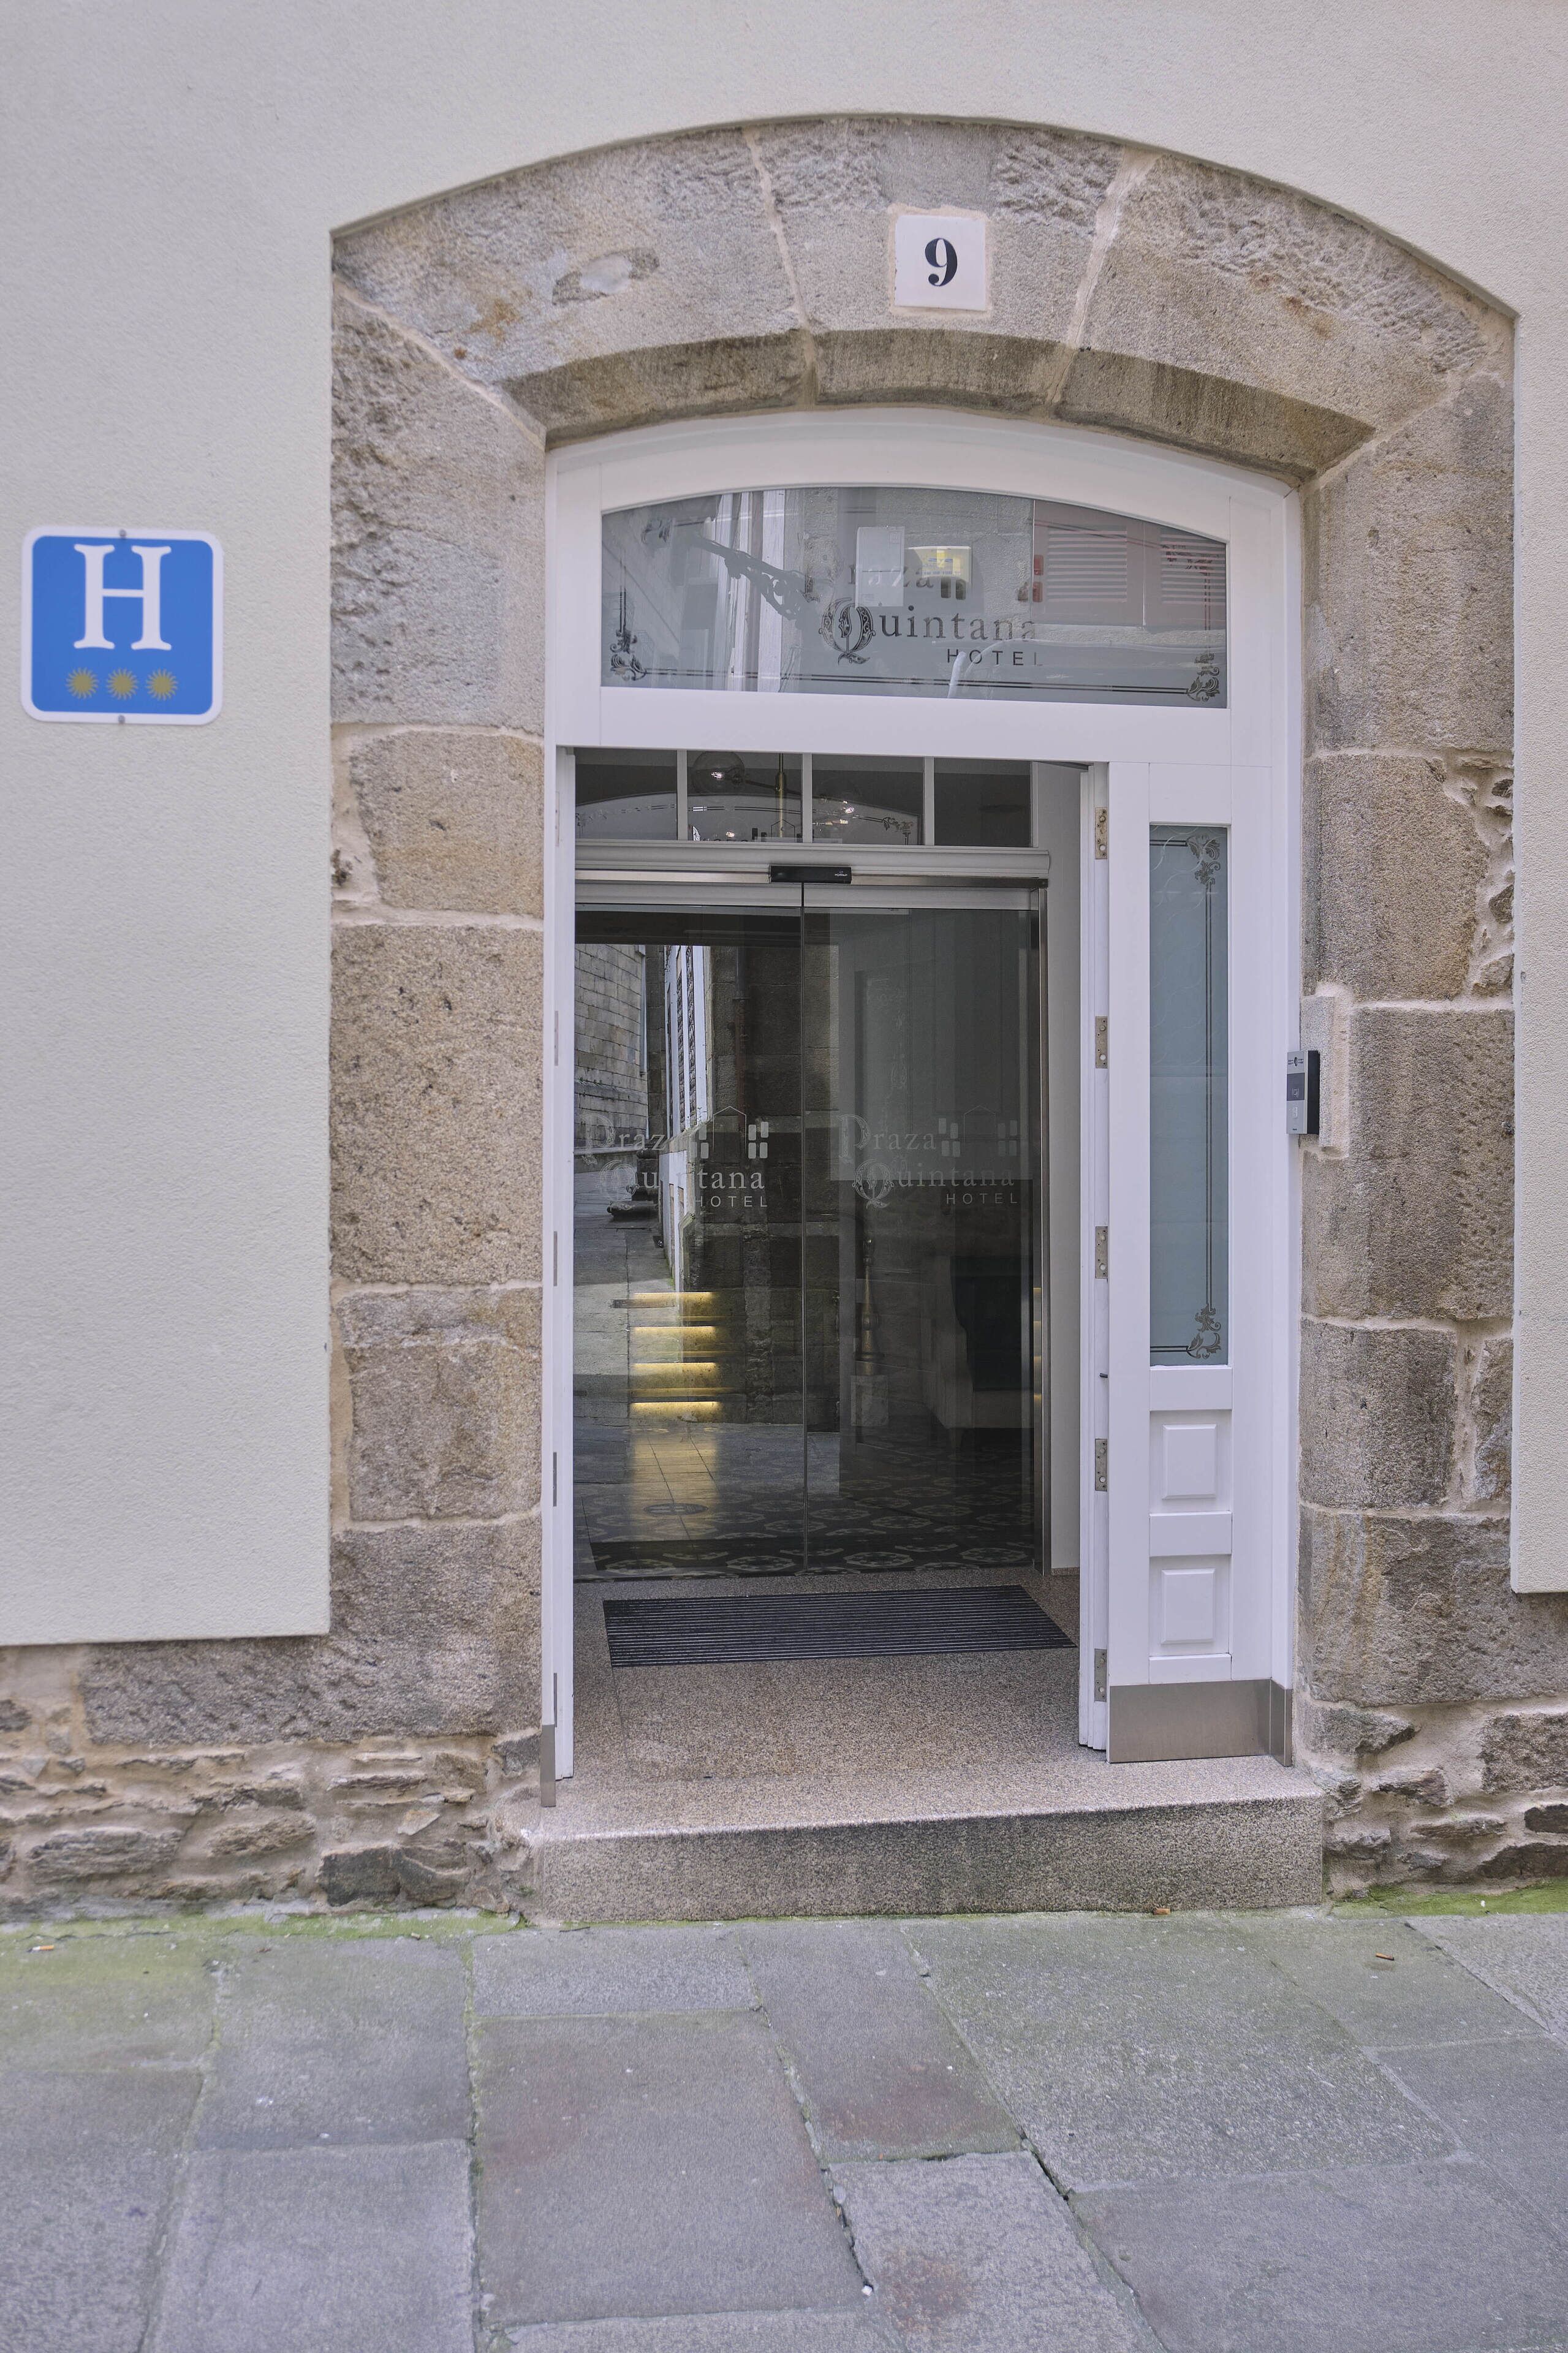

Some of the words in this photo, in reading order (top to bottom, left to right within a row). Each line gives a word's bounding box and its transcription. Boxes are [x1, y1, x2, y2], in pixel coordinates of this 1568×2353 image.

[925, 238, 958, 287] 9
[74, 544, 172, 651] H
[819, 597, 1036, 666] Quintana
[947, 648, 1043, 666] HOTEL
[838, 1114, 937, 1164] Praza
[852, 1159, 1015, 1210] Quintana
[945, 1192, 1019, 1205] HOTEL
